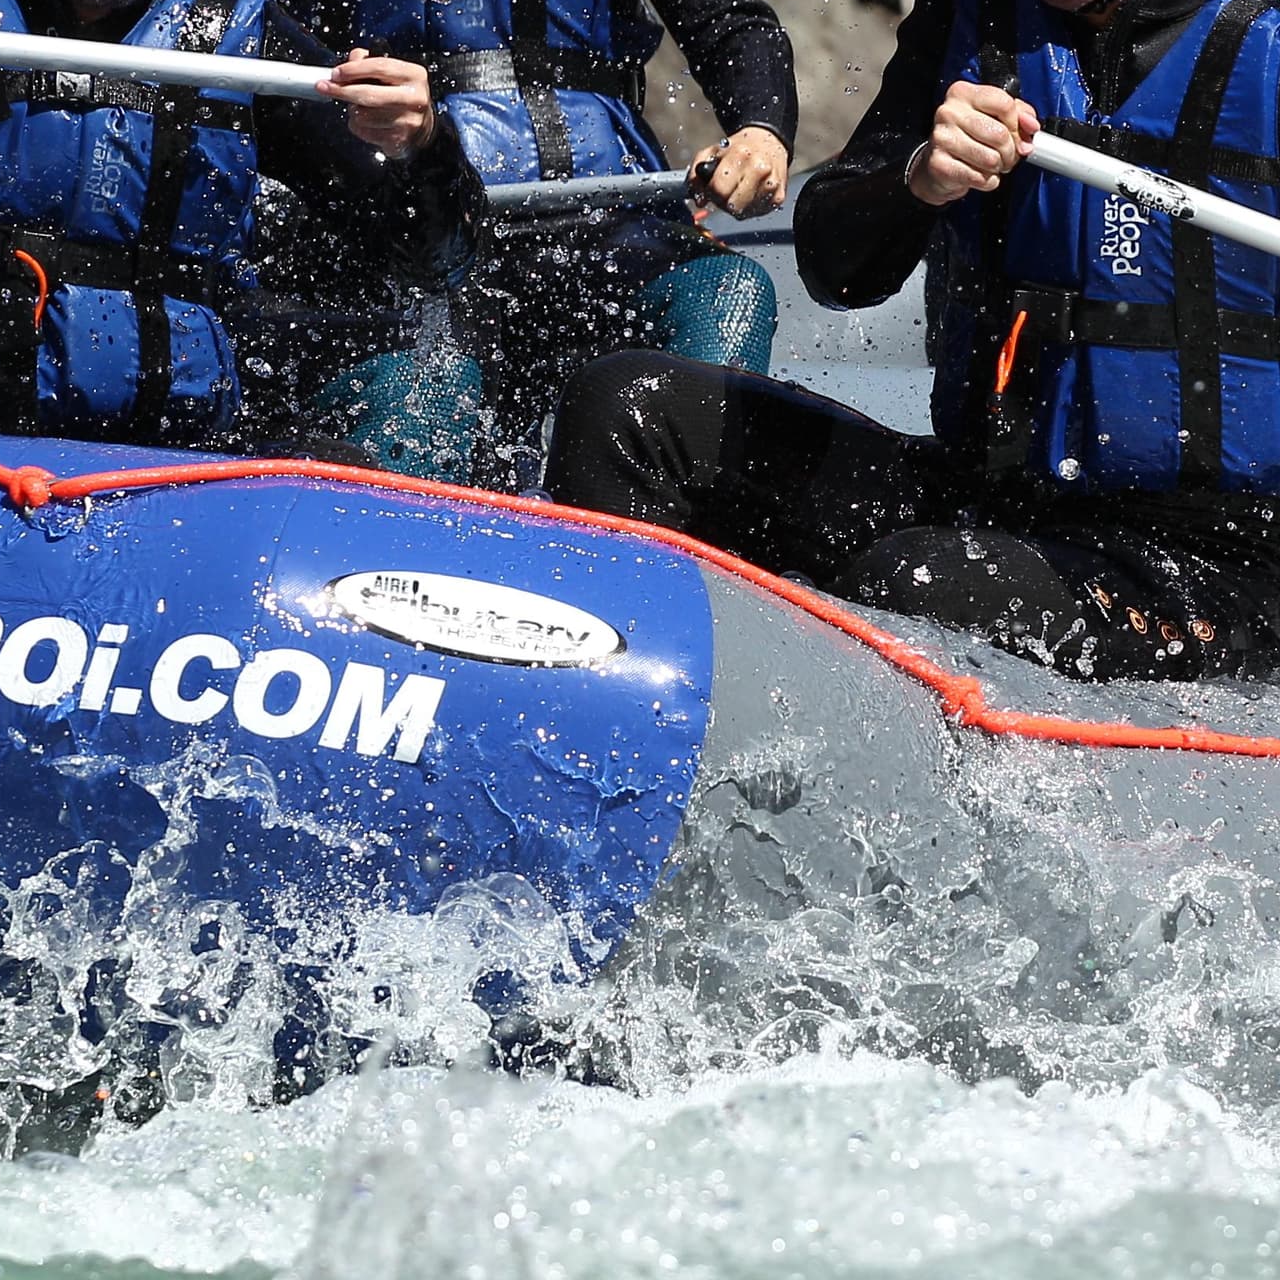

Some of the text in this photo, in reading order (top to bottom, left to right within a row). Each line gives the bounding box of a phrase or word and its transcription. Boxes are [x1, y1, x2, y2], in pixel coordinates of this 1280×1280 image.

[1100, 199, 1119, 257] River
[1111, 193, 1149, 276] Peop
[373, 574, 410, 594] AIRE
